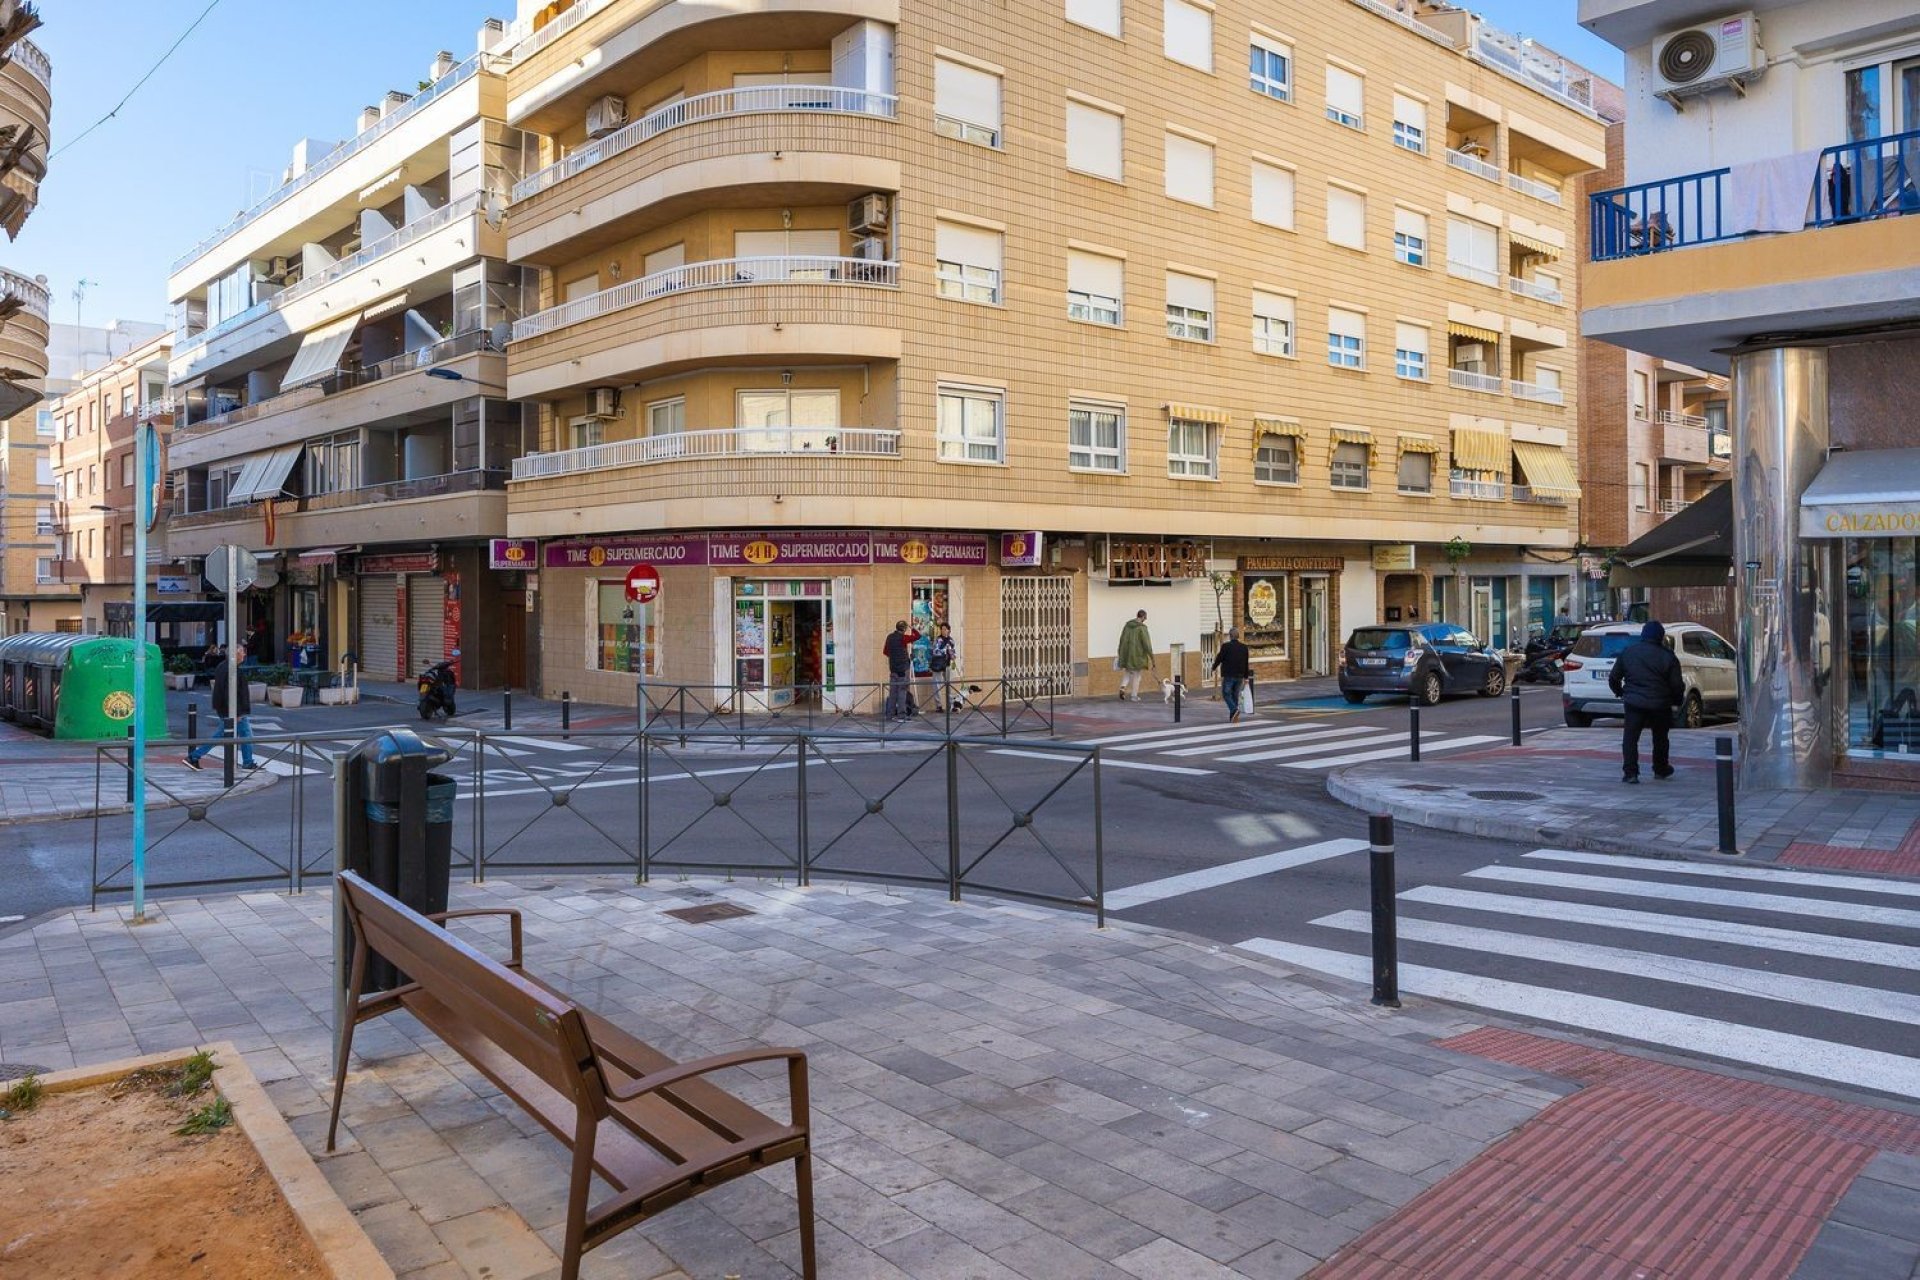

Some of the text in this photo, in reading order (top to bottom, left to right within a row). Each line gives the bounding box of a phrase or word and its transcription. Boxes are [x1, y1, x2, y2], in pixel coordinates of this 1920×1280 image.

[1826, 512, 1920, 532] CALZADO
[567, 549, 587, 562] TIME
[606, 546, 686, 561] SUPERMERCADO
[711, 544, 740, 558] TIME
[781, 543, 869, 558] SUPERMERCADO
[874, 543, 898, 558] TIME
[930, 544, 985, 559] SUPERMARKET
